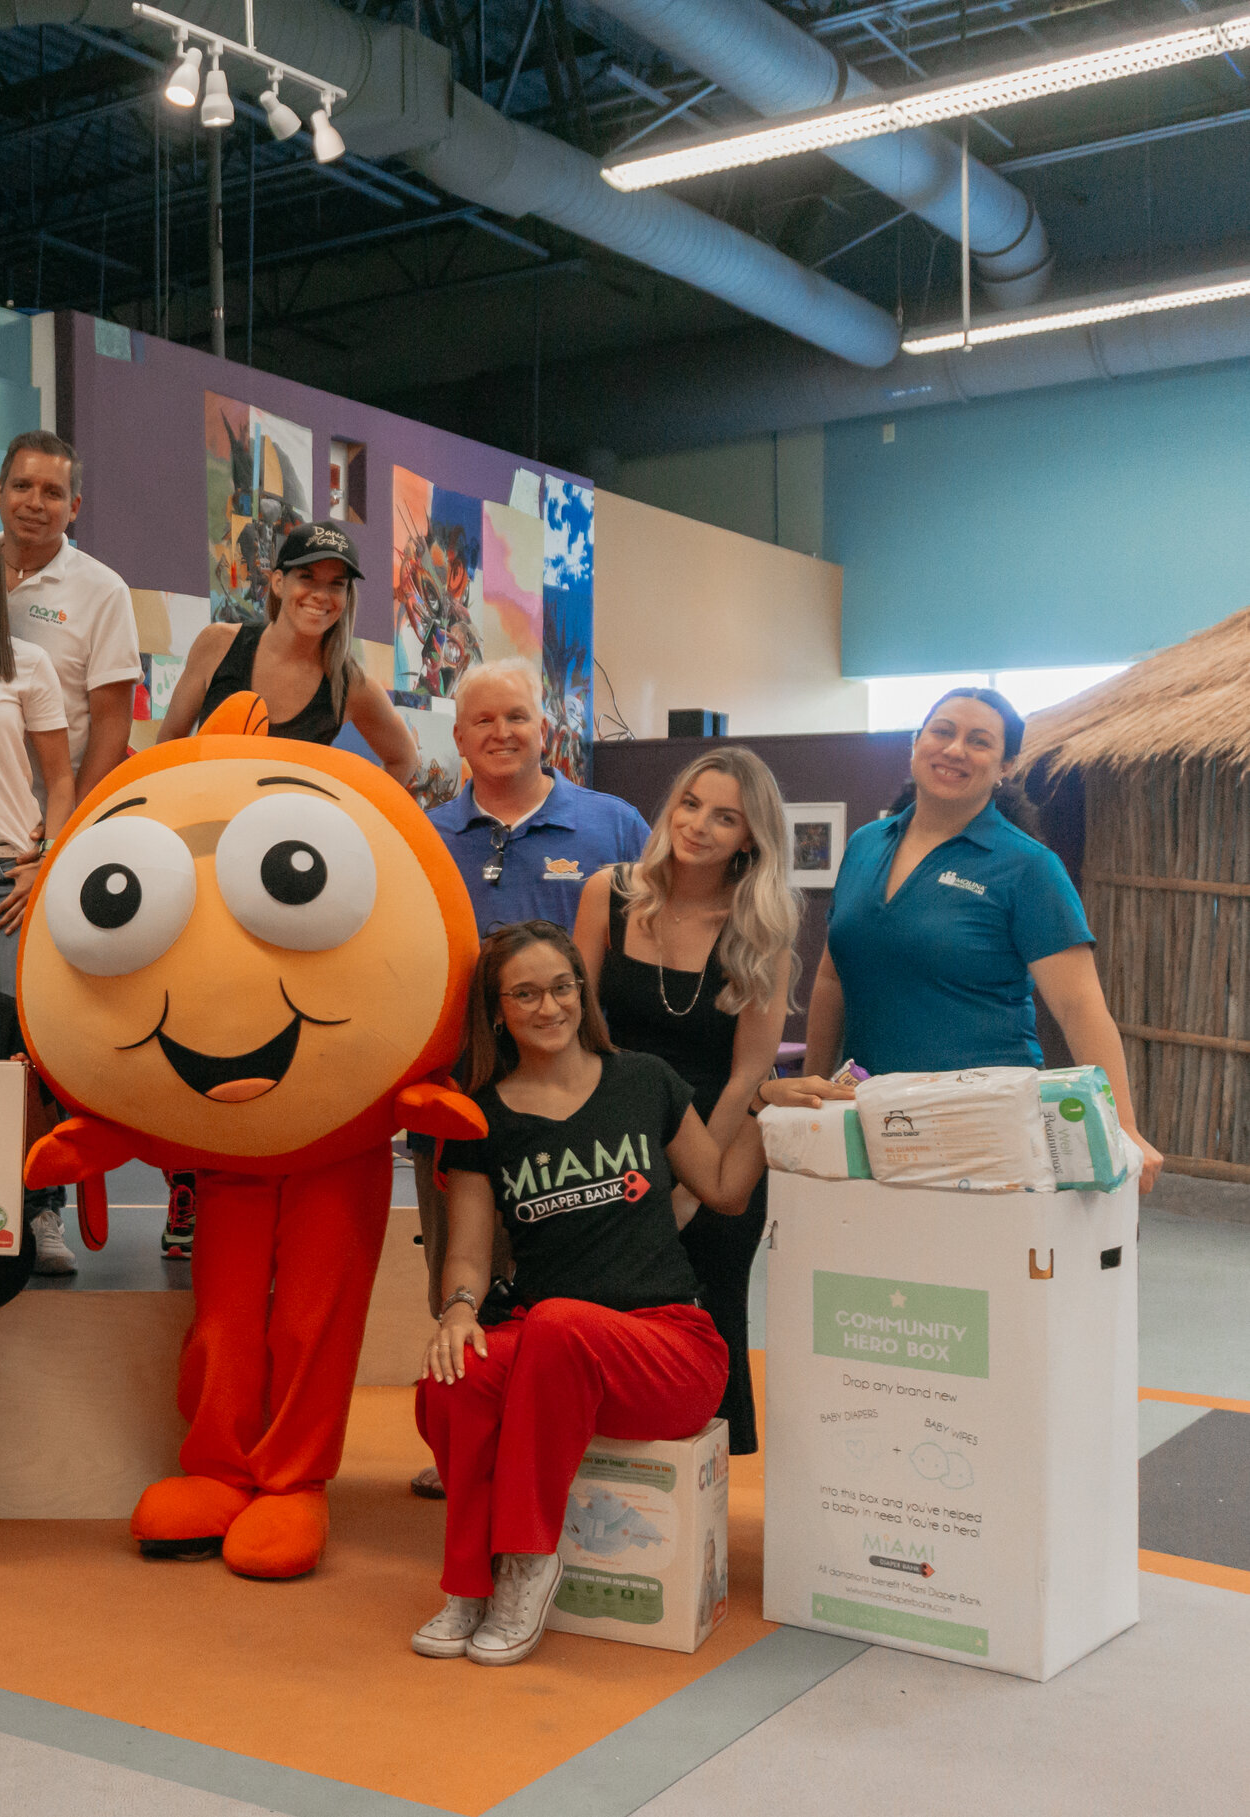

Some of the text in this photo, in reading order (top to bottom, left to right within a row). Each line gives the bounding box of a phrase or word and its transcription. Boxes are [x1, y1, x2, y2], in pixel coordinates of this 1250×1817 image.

[29, 604, 67, 621] nani's
[1058, 1127, 1073, 1156] Well
[535, 1183, 623, 1215] DIAPER BANK
[835, 1309, 967, 1342] COMMUNITY
[843, 1331, 950, 1362] HERO BOX
[842, 1373, 958, 1403] Drop any brand new
[820, 1408, 879, 1424] BABY DIAPERS
[924, 1417, 979, 1446] BABY WIPES
[821, 1501, 830, 1510] a
[832, 1502, 860, 1518] baby
[862, 1507, 872, 1517] in
[906, 1515, 940, 1531] You're
[942, 1523, 951, 1533] a
[953, 1525, 981, 1538] hero!
[841, 1488, 857, 1500] this
[859, 1491, 879, 1504] box
[881, 1496, 903, 1509] and
[905, 1502, 940, 1516] you've
[942, 1506, 982, 1524] helped
[817, 1564, 828, 1574] All
[828, 1567, 870, 1583] donations
[871, 1576, 901, 1589] benefit
[901, 1580, 927, 1595] Miami
[927, 1586, 958, 1602] Diaper
